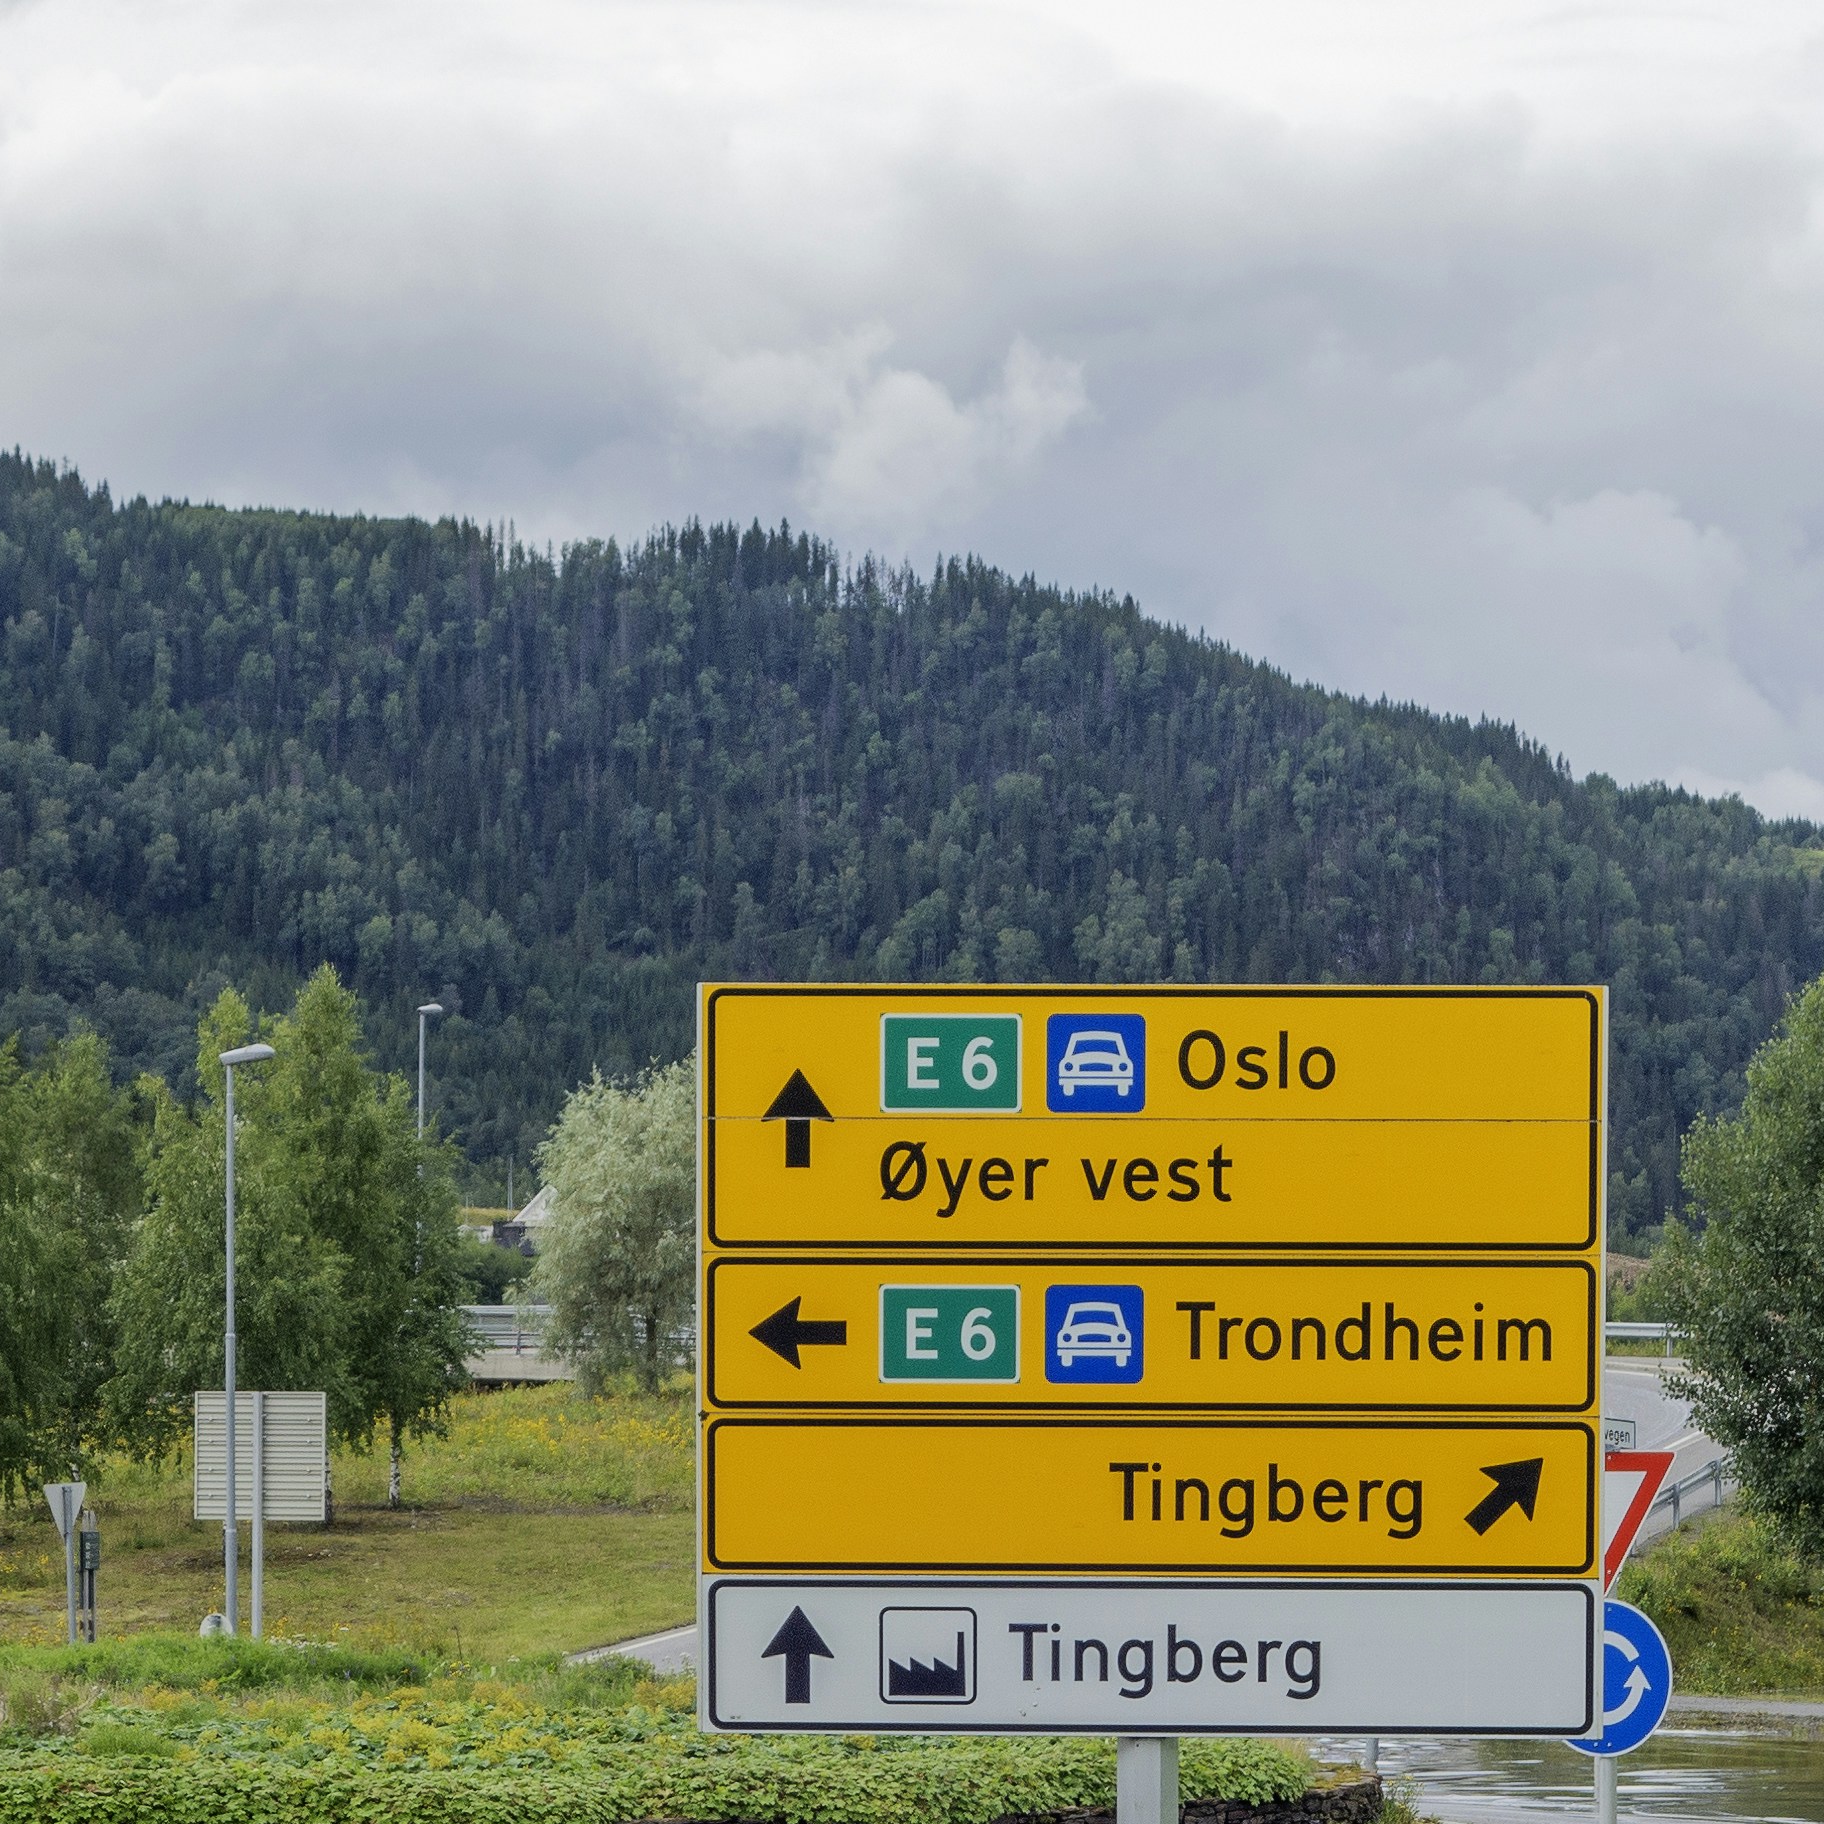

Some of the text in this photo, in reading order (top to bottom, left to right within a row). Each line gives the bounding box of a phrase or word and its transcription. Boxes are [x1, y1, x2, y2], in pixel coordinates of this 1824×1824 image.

[1178, 1029, 1336, 1090] Oslo
[880, 1140, 1233, 1219] Øyer vest
[1175, 1301, 1552, 1362] Trondheim
[1109, 1462, 1423, 1540] Tingberg
[1008, 1623, 1321, 1700] Tingberg
